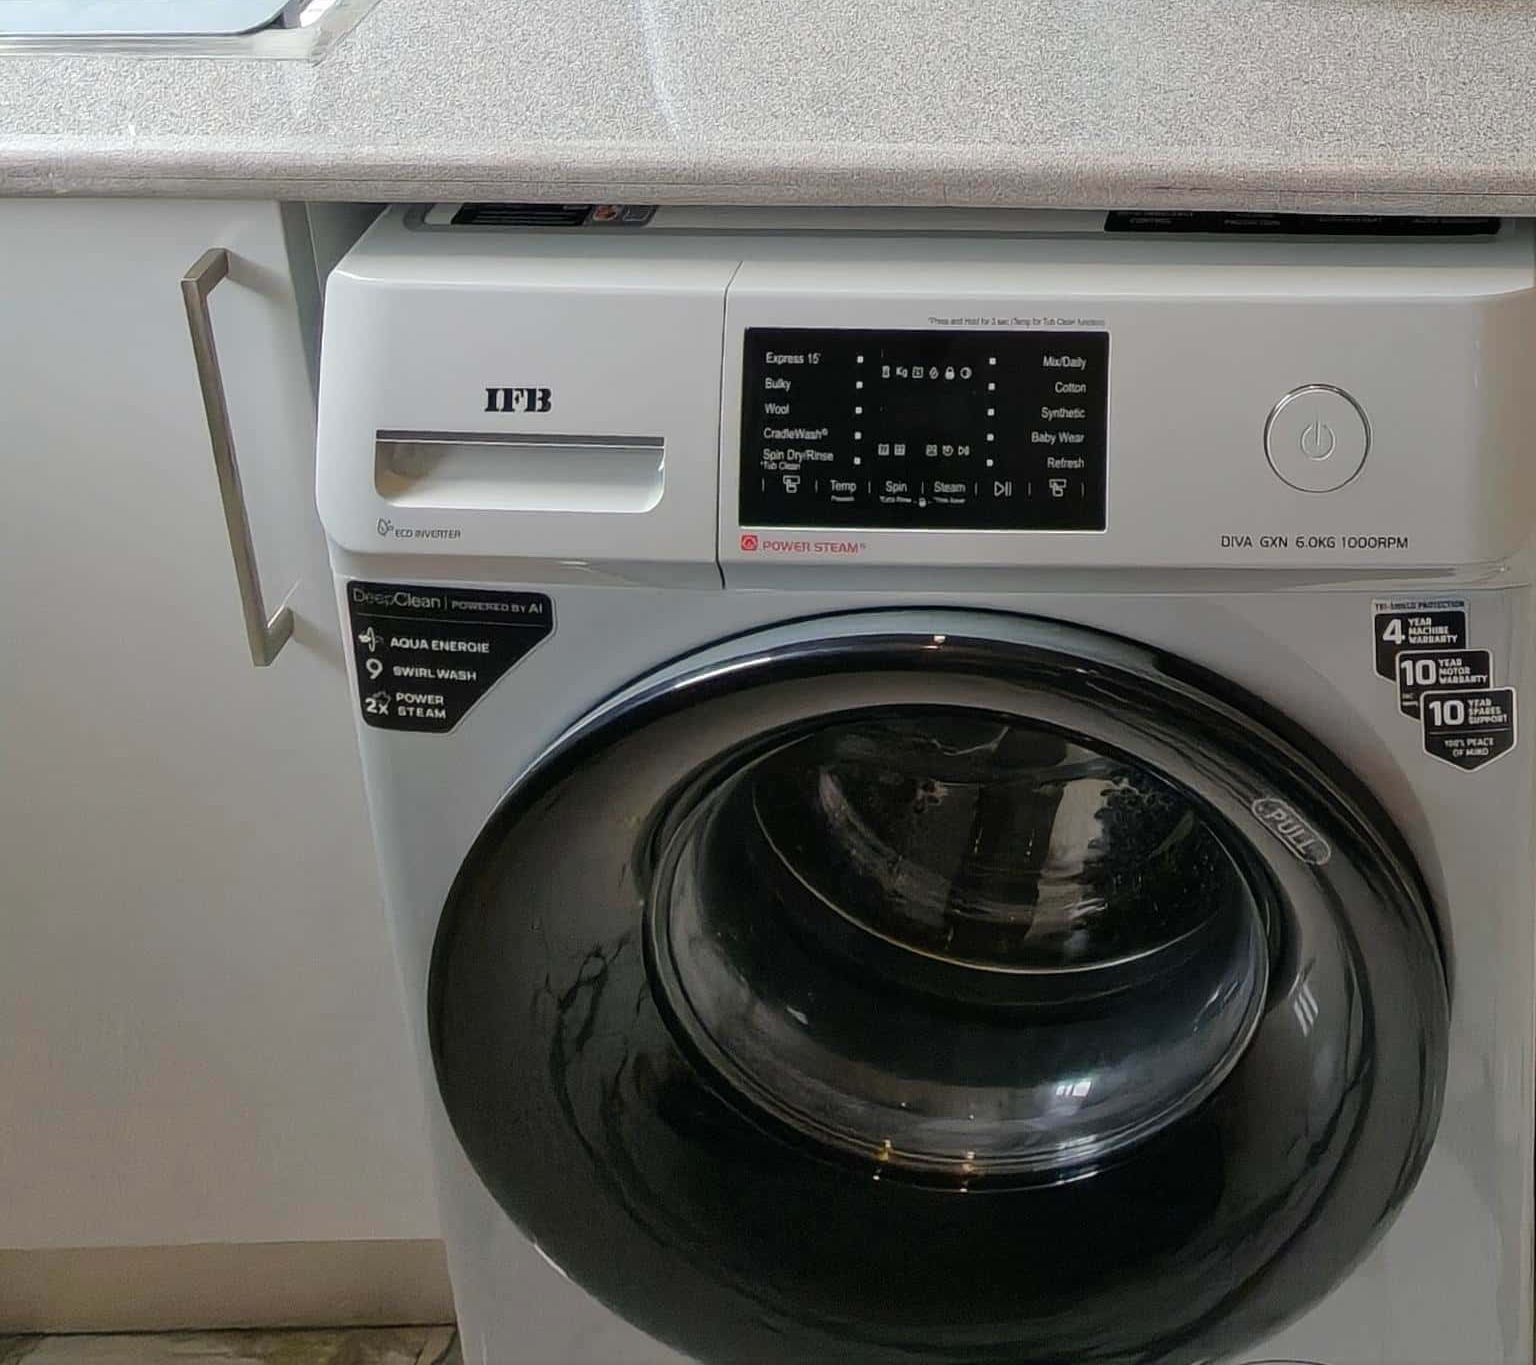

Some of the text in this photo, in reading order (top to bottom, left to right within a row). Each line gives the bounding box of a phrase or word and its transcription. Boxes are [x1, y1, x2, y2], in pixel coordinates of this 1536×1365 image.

[766, 351, 804, 365] Express
[1043, 355, 1087, 370] Mix/Daily
[765, 377, 791, 391] Bulky
[1055, 381, 1086, 394] Cotton
[484, 388, 553, 412] IFB
[764, 403, 790, 414] Wool
[1041, 407, 1086, 421] Synthetic
[1031, 431, 1085, 445] Baby Wear
[763, 448, 834, 463] Spin Dry/Rinse
[778, 461, 801, 470] Clean
[1047, 456, 1085, 469] Refresh
[830, 479, 966, 494] Temp Spin Steam
[395, 529, 461, 539] ECO INVERTER
[762, 540, 811, 552] POWER
[1221, 535, 1408, 549] DIVA GXN 6.0KG 1000RPM
[352, 587, 543, 614] DeepClean POWERED BY AI
[1408, 617, 1432, 626] YEAR
[1408, 626, 1449, 635] MACHINE
[390, 637, 490, 653] AQUA ENERGIE
[1408, 635, 1458, 644] WARRANTY
[1438, 658, 1463, 667] YEAR
[366, 658, 477, 681] 9 SWIRL WASH
[1401, 659, 1437, 686] 10
[1439, 667, 1471, 675] MOTOR
[1439, 674, 1488, 684] WARRANTY
[396, 692, 444, 705] POWER
[1467, 698, 1492, 706] YEAR
[397, 706, 446, 719] STEAM
[1429, 700, 1465, 726] 10
[1469, 706, 1501, 715] SPARES
[1468, 714, 1508, 724] SUPPORT
[1467, 737, 1494, 746] PEACE
[1452, 748, 1489, 757] OF MIND
[1264, 808, 1316, 854] PULL
